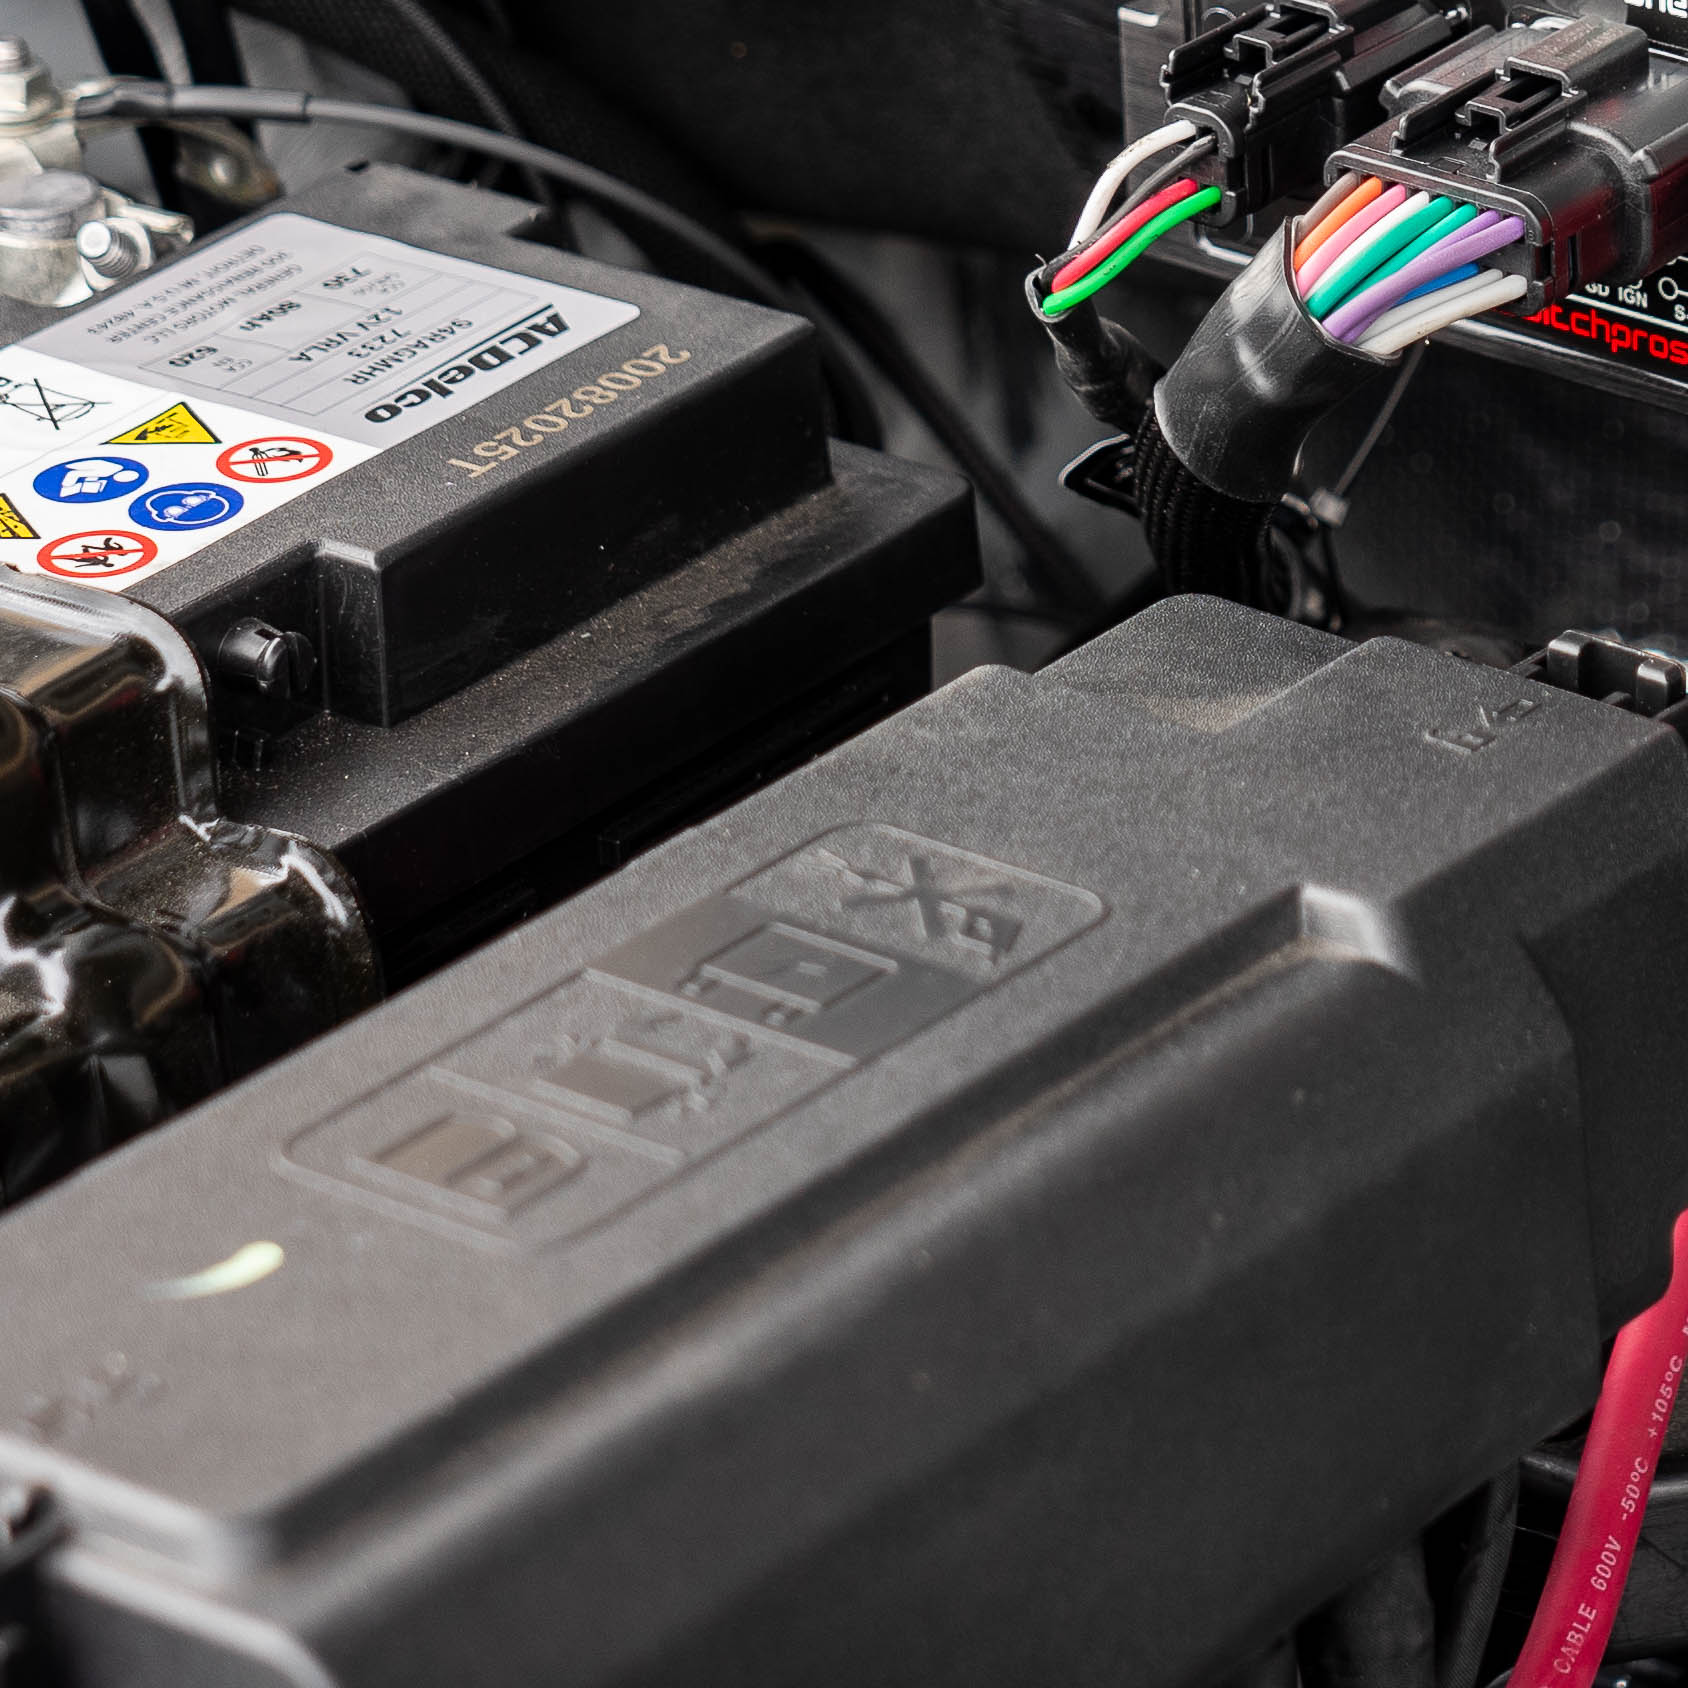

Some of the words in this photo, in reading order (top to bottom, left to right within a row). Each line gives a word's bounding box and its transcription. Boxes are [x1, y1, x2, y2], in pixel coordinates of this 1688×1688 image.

[363, 311, 571, 424] ACDelco
[446, 343, 692, 479] 20082025T
[1553, 1602, 1597, 1675] CABLE
[1590, 1535, 1623, 1592] 600V
